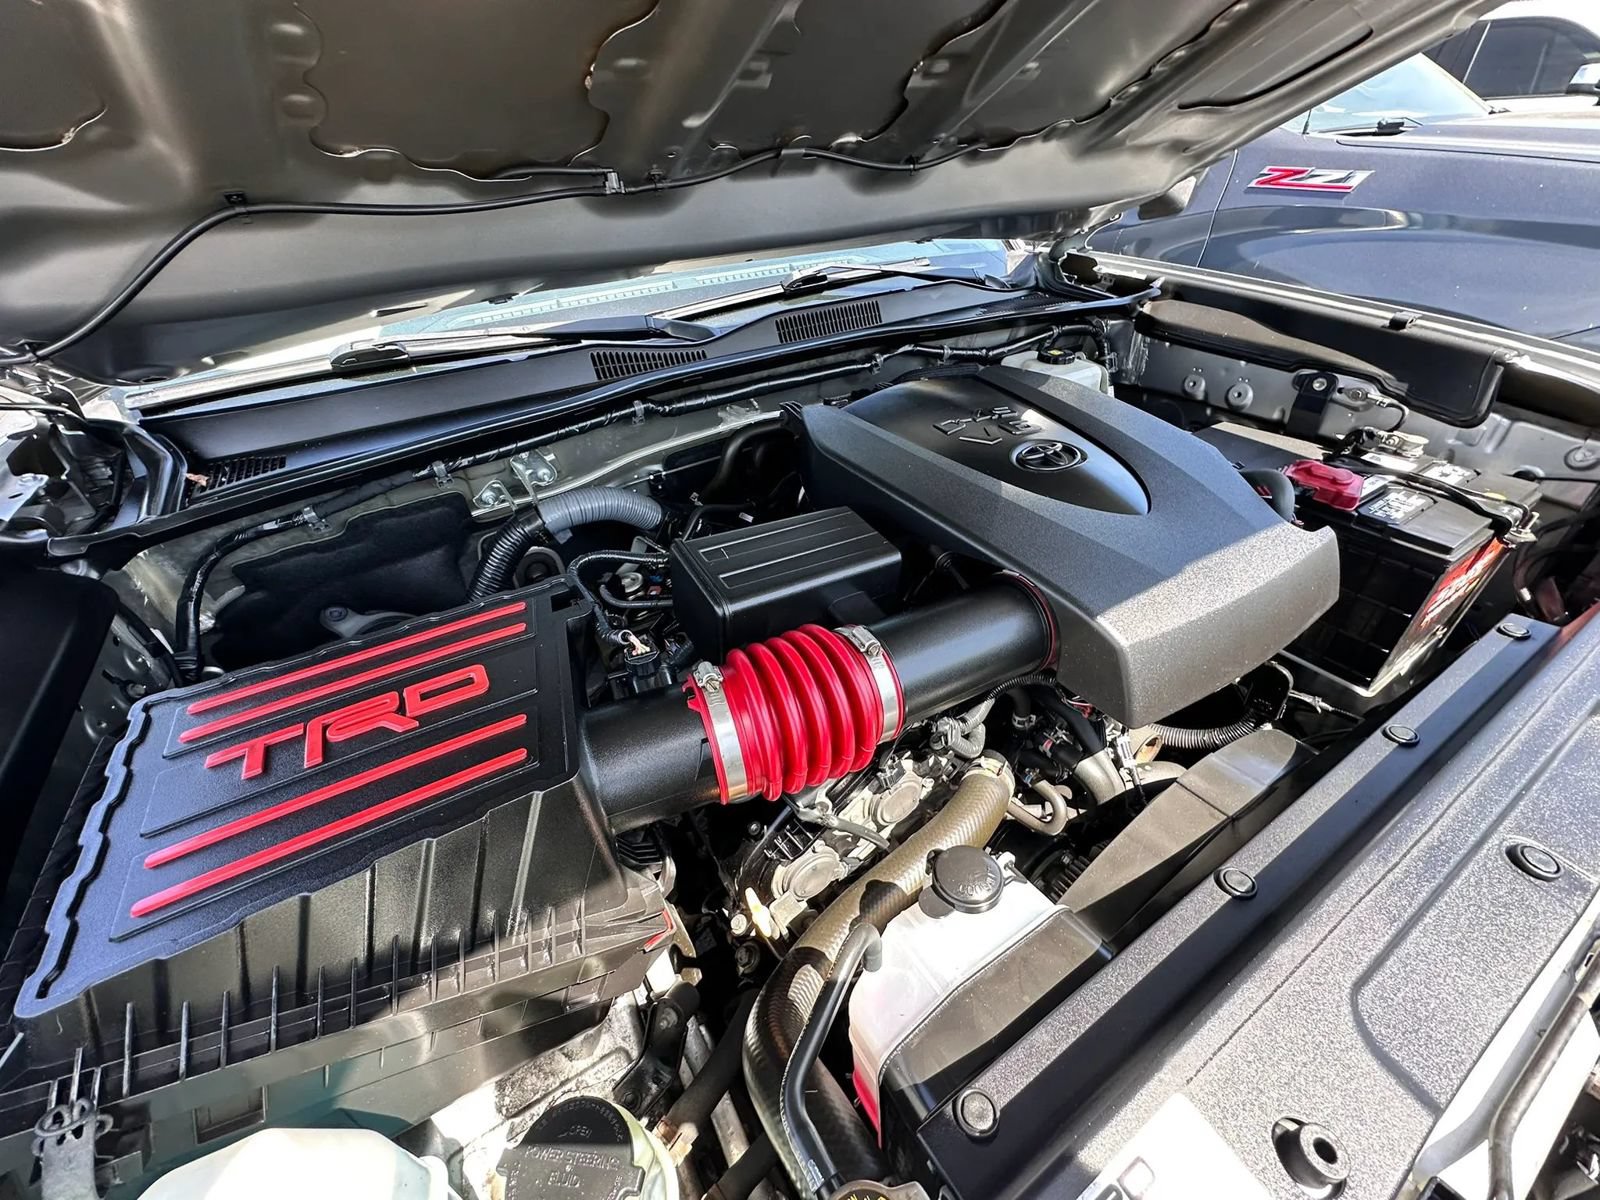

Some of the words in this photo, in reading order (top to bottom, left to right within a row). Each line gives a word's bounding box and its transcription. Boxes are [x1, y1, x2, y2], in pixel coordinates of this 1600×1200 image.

[1247, 166, 1376, 193] Z71
[204, 664, 490, 780] TRD
[568, 1123, 593, 1139] OPEN
[524, 1145, 564, 1163] POWER
[548, 1171, 581, 1189] FLUID
